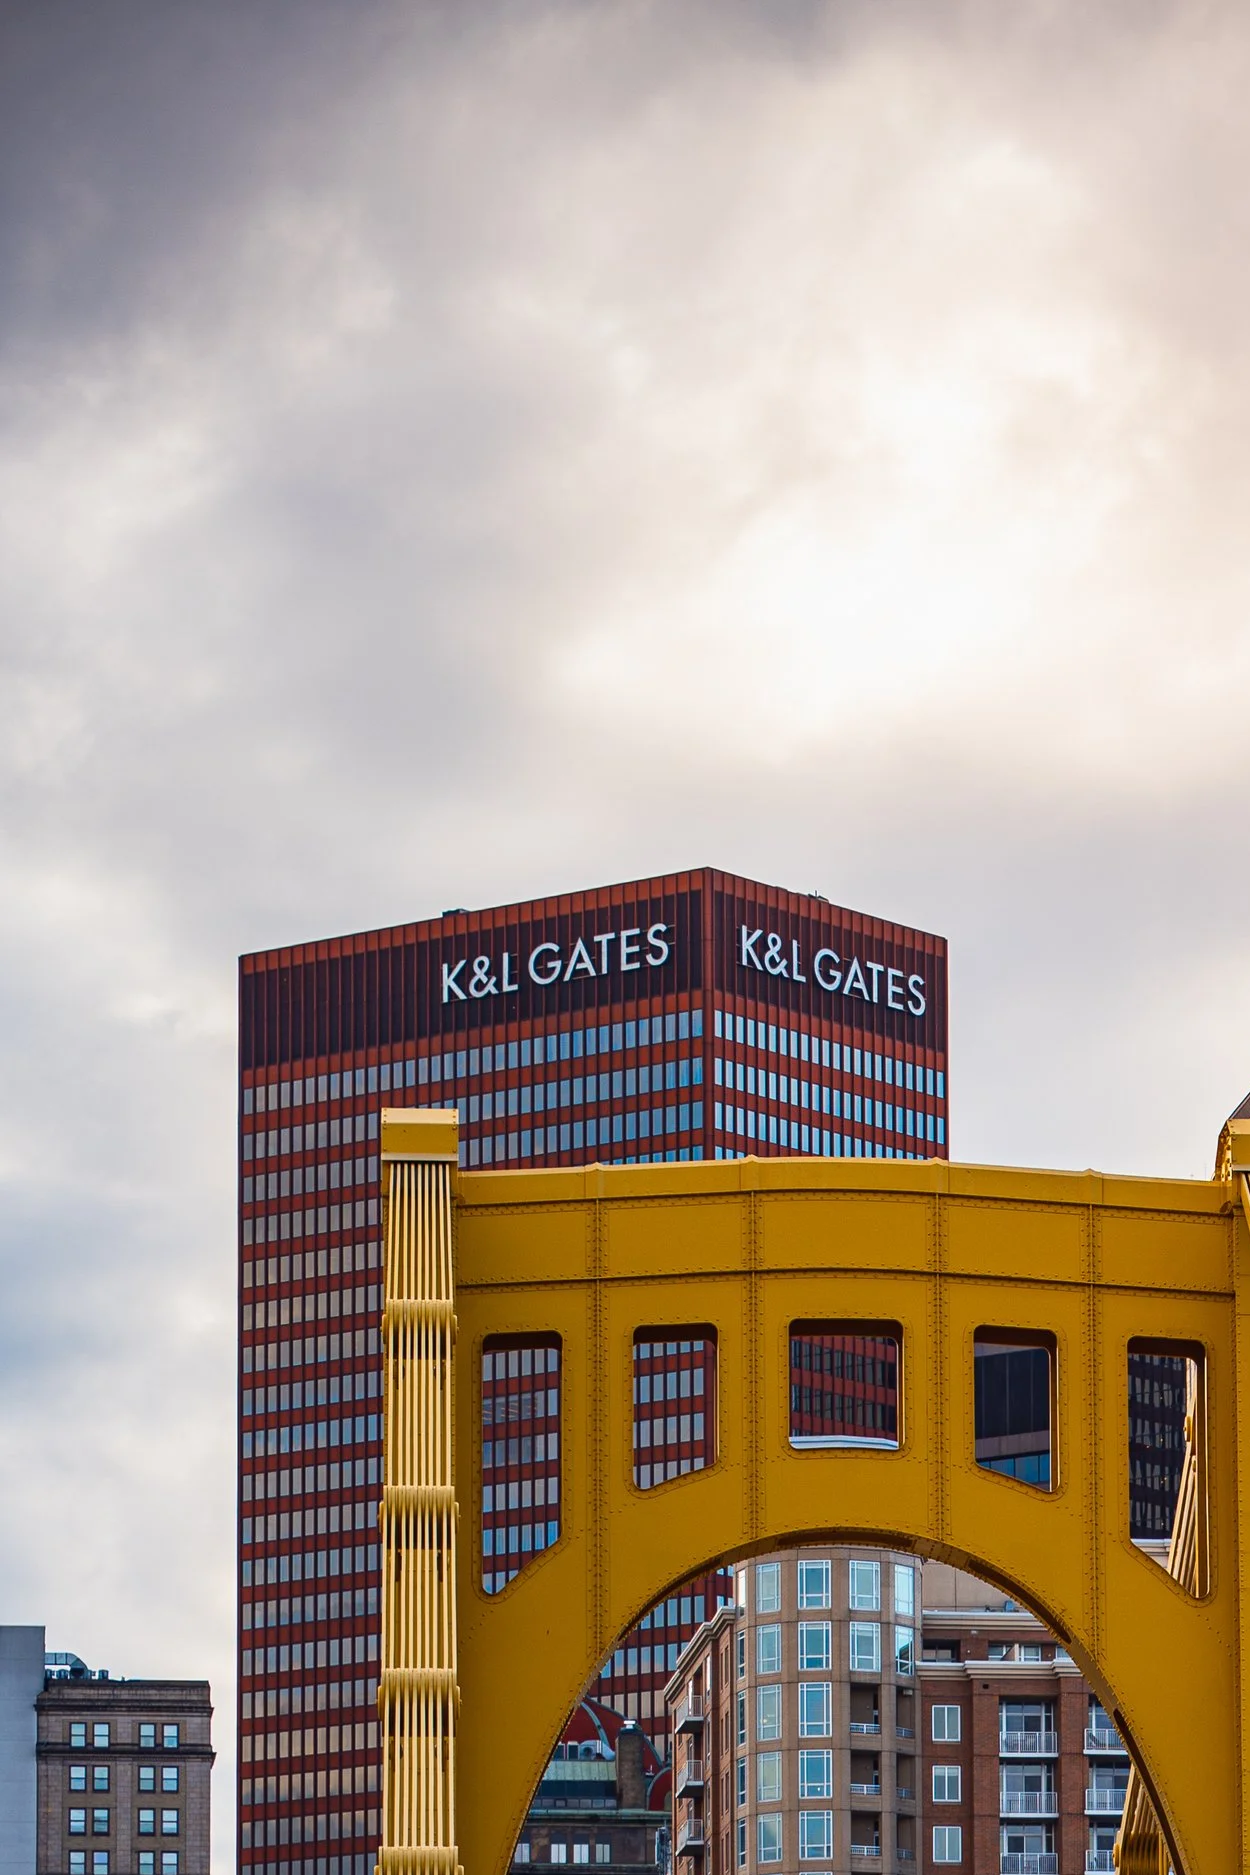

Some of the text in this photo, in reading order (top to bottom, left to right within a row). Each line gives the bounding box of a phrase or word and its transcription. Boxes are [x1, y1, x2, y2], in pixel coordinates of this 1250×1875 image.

[442, 923, 669, 1003] K&L GATES
[741, 924, 926, 1016] K&L GATES
